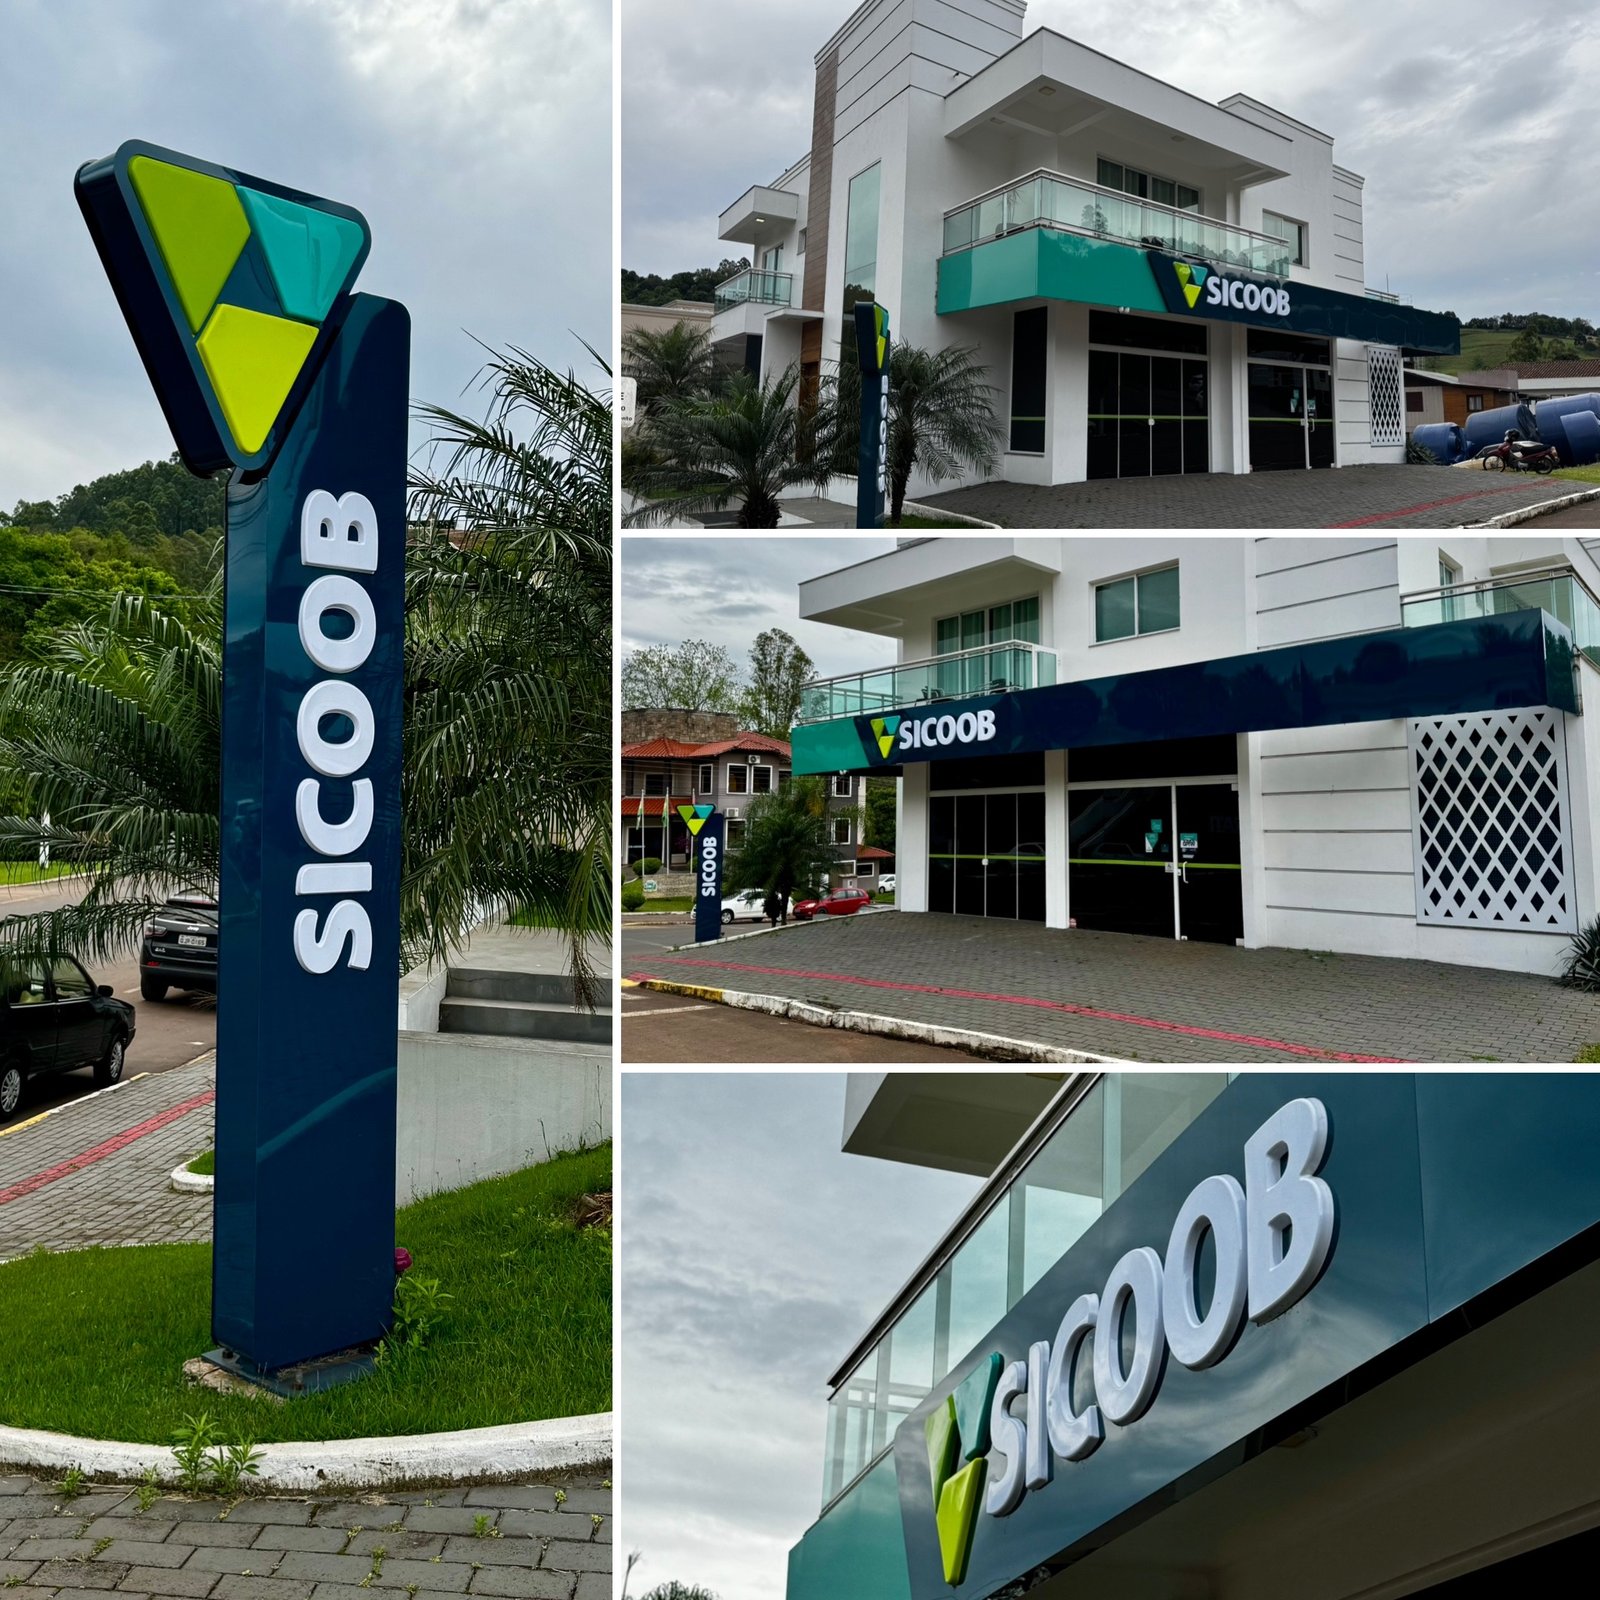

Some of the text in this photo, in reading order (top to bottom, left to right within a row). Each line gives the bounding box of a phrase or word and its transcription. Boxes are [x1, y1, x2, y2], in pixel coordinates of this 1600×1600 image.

[1206, 276, 1291, 316] SICOOB
[293, 489, 378, 974] SICOOB
[899, 709, 997, 750] SICOOB
[701, 836, 717, 897] SICOOB
[986, 1097, 1335, 1517] SICOOB
